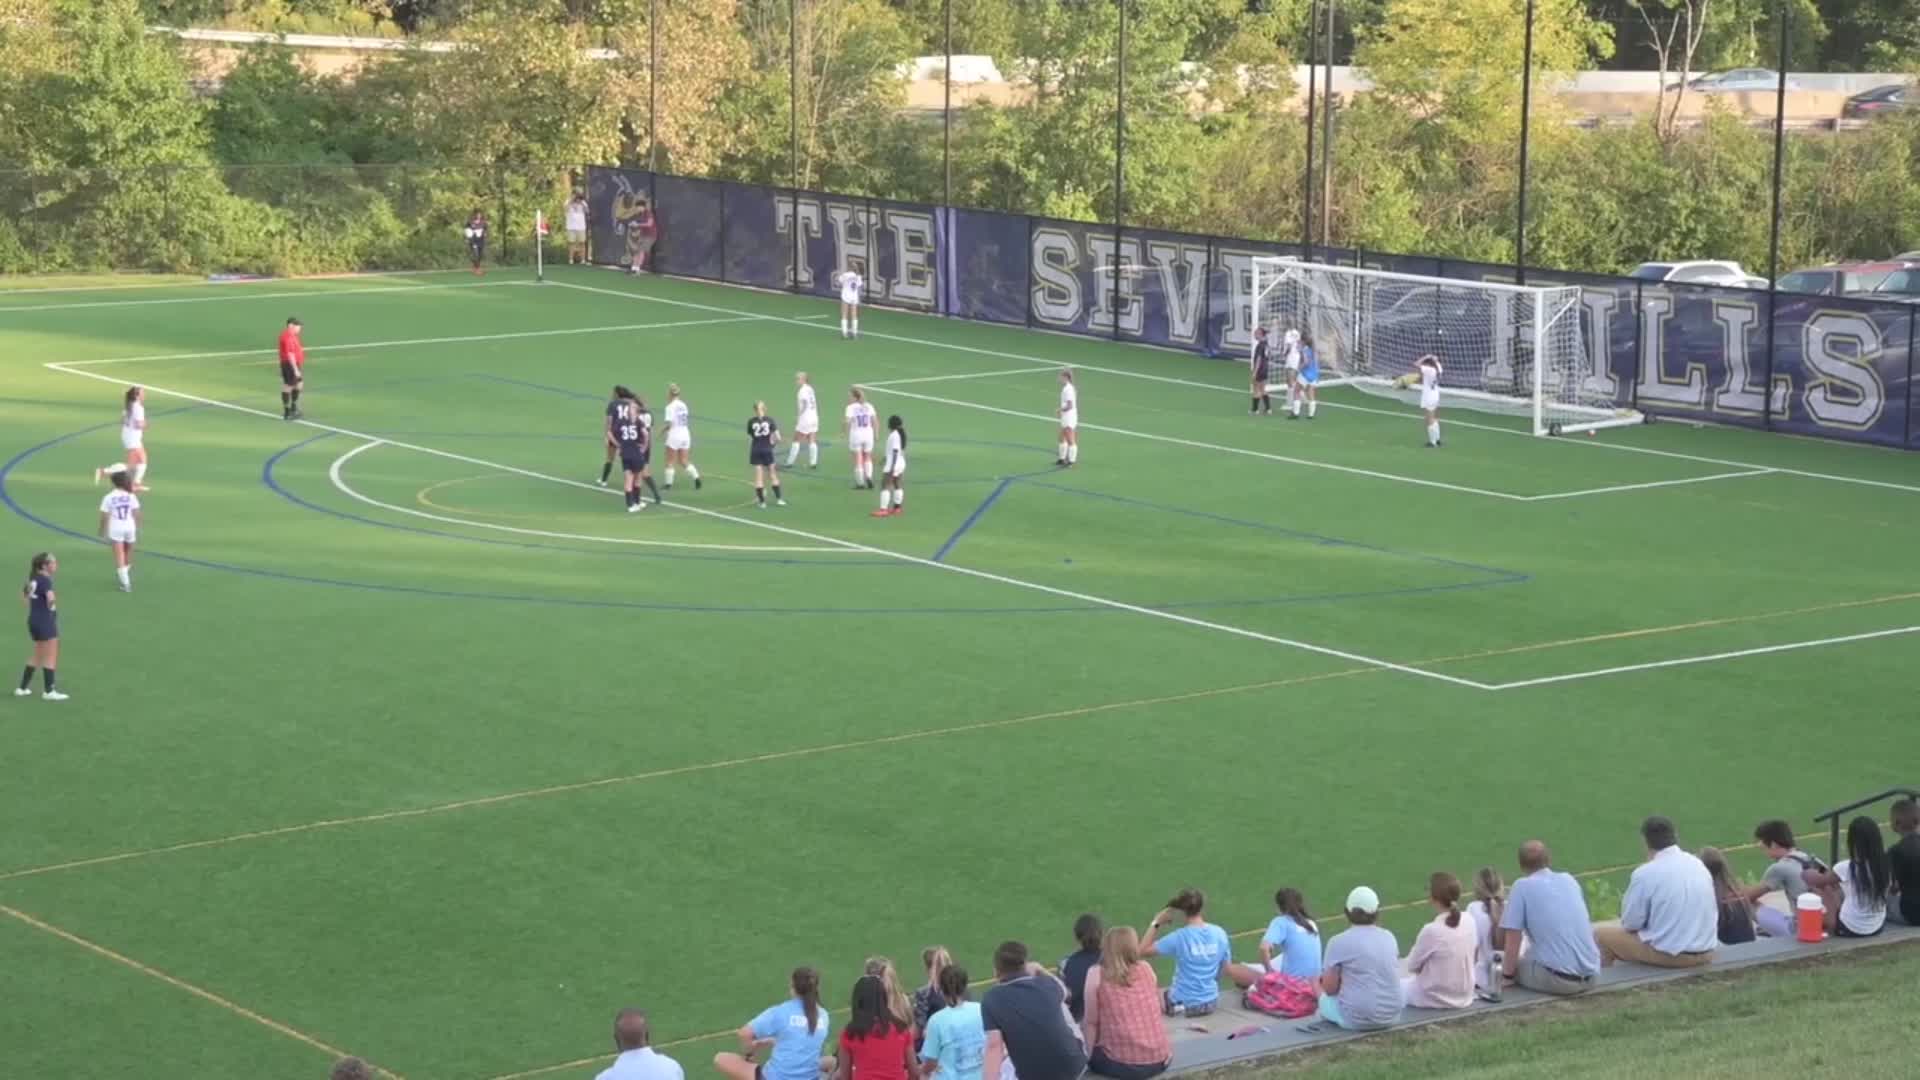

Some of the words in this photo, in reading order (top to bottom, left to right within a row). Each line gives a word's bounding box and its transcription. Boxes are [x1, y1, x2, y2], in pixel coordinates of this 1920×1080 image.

[774, 196, 936, 306] THE
[1031, 227, 1382, 370] SEVEN
[1481, 274, 1886, 431] HILLS
[620, 424, 639, 441] 35
[752, 421, 770, 438] 23
[116, 504, 129, 520] 17
